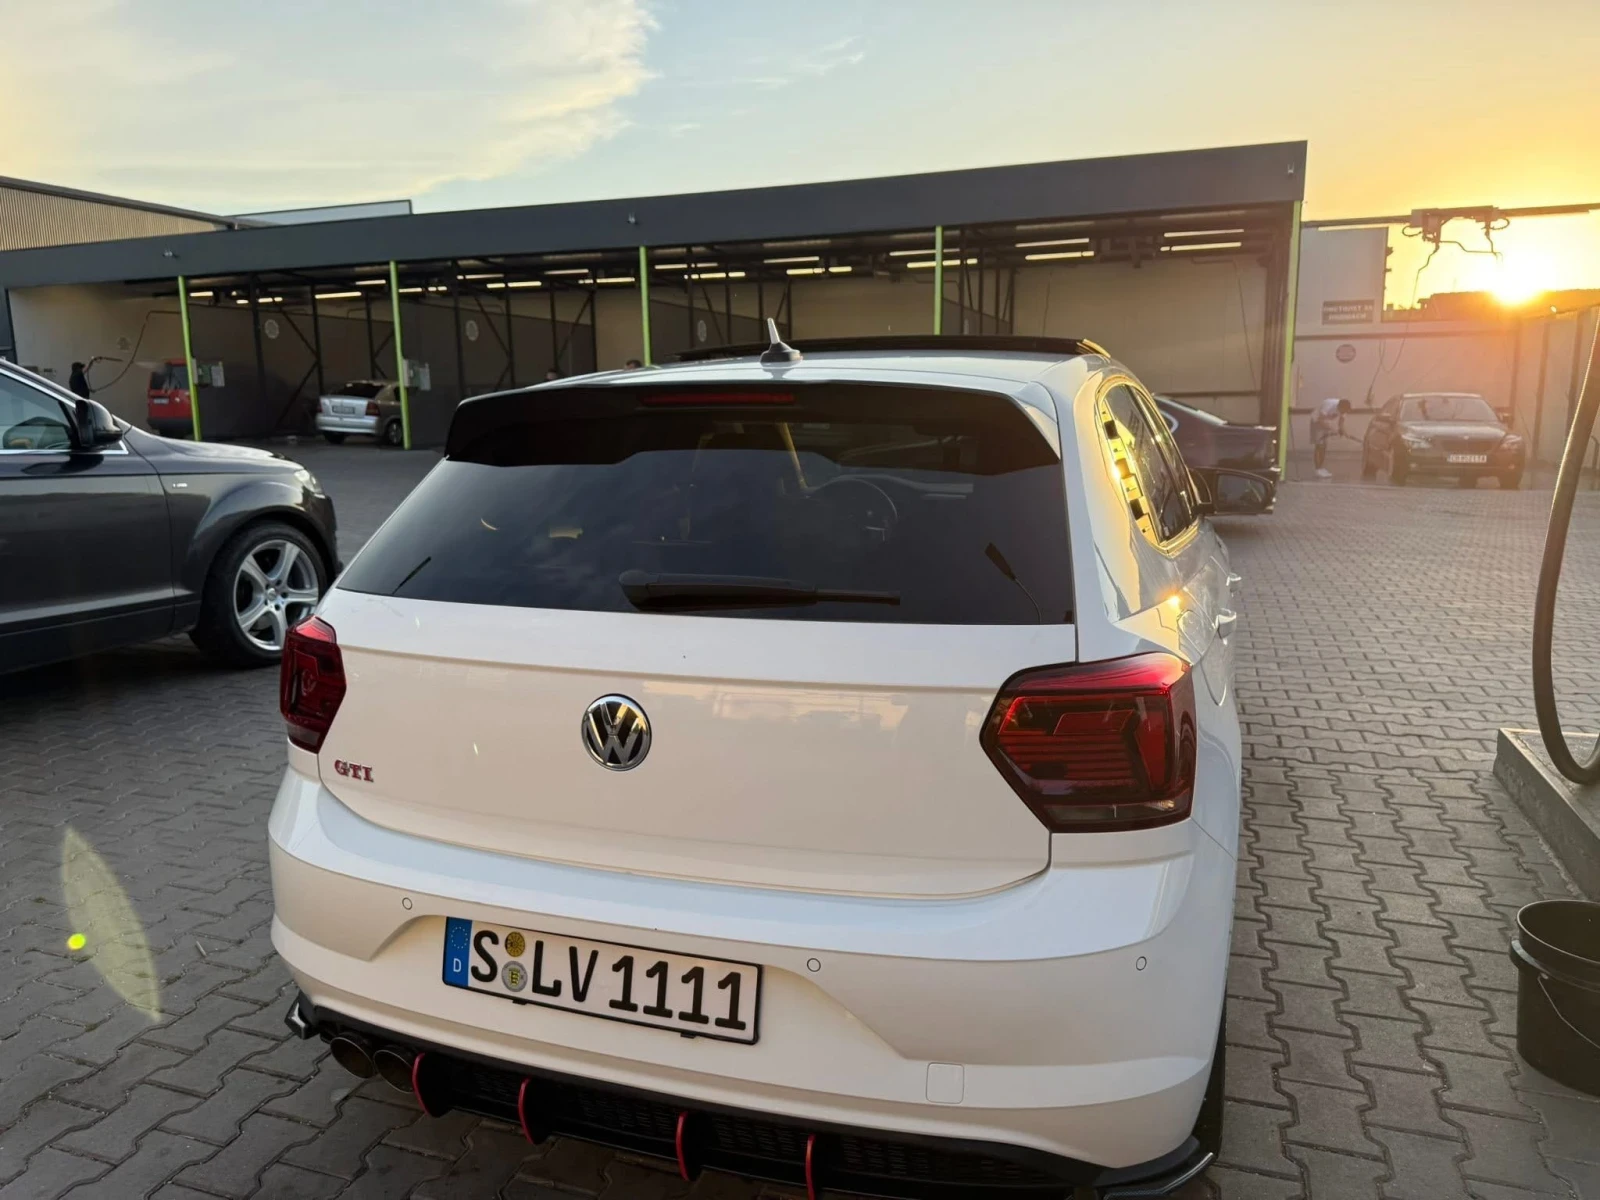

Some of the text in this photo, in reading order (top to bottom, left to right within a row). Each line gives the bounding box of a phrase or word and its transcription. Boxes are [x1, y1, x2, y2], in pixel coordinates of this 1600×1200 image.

[583, 697, 650, 768] VW
[334, 759, 374, 783] GTI
[453, 957, 462, 973] D
[470, 930, 499, 982] S
